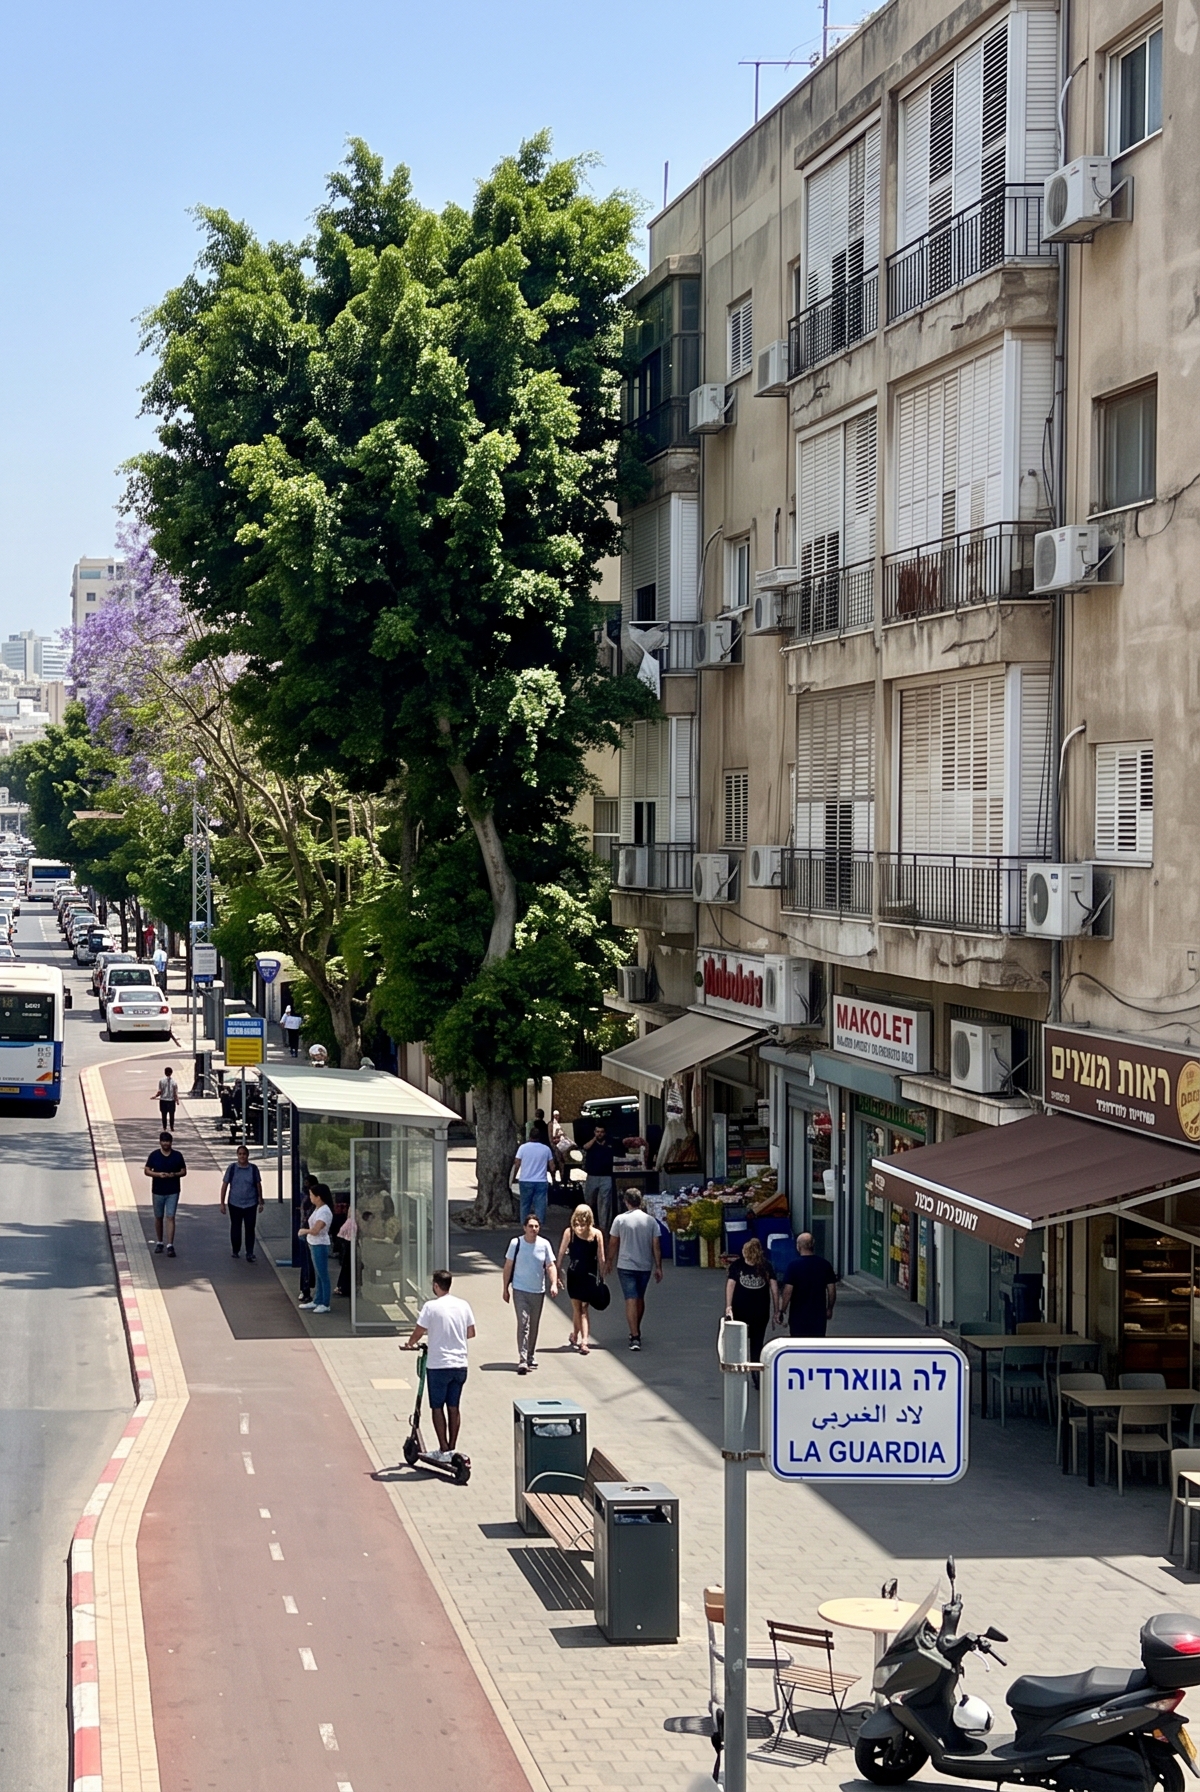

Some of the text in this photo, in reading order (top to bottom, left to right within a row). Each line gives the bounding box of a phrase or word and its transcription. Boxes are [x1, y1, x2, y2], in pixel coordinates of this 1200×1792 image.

[837, 1003, 913, 1045] MAKOLET
[1117, 1059, 1171, 1106] ראות
[788, 1361, 947, 1391] לה גווארדיה
[789, 1440, 946, 1463] LA GUARDIA
